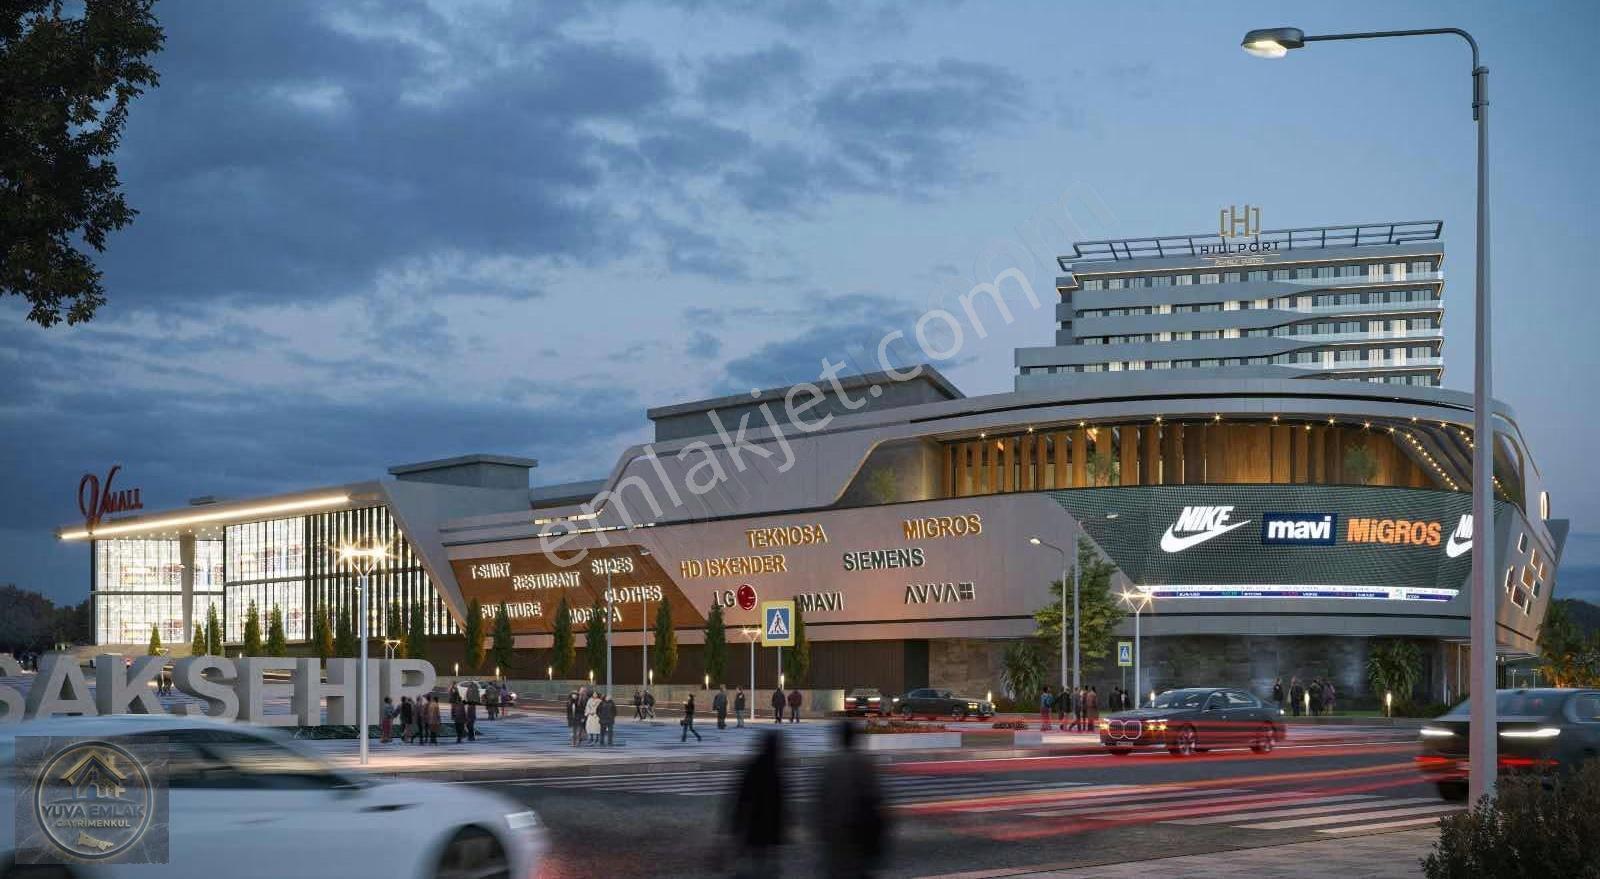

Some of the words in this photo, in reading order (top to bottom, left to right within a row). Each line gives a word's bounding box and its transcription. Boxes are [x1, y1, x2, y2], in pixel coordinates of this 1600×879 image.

[1200, 241, 1279, 254] HILLPORT
[903, 513, 983, 540] MIGROS
[1174, 505, 1234, 532] NIKE
[1267, 515, 1332, 540] mavi
[745, 523, 829, 549] TEKNOSA
[591, 556, 635, 576] SHOES
[679, 559, 702, 579] HD
[705, 554, 788, 577] ISKENDER
[842, 547, 926, 571] SIEMENS
[471, 562, 511, 580] T-SHIRT
[512, 571, 581, 591] RESTURANT
[604, 585, 663, 604] CLOTHES
[713, 590, 737, 609] LG
[798, 591, 845, 613] MAVI
[481, 602, 543, 620] FURITURE
